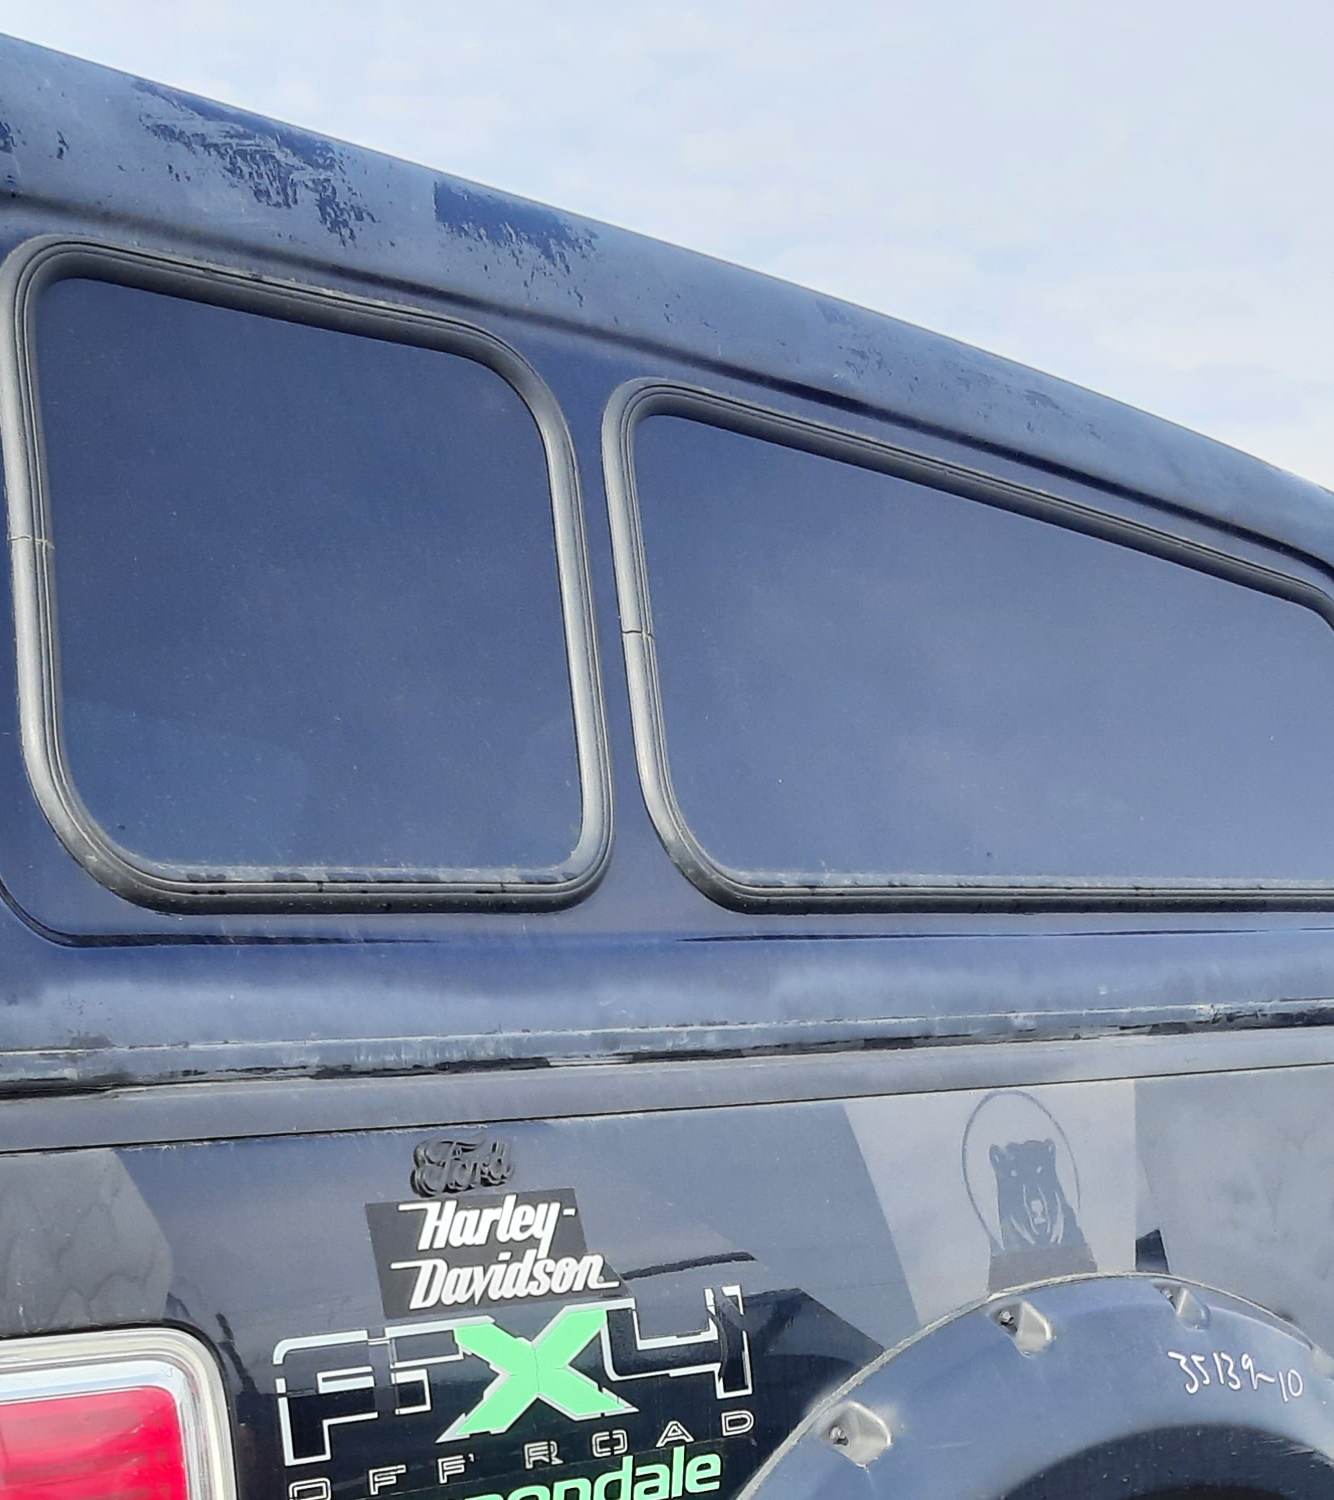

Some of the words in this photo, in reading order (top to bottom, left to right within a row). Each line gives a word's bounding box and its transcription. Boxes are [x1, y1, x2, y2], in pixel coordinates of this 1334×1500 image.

[409, 1134, 516, 1198] Ford
[390, 1251, 621, 1311] Davidson
[1167, 1351, 1304, 1402] 35139-10
[523, 1409, 755, 1469] ROAD
